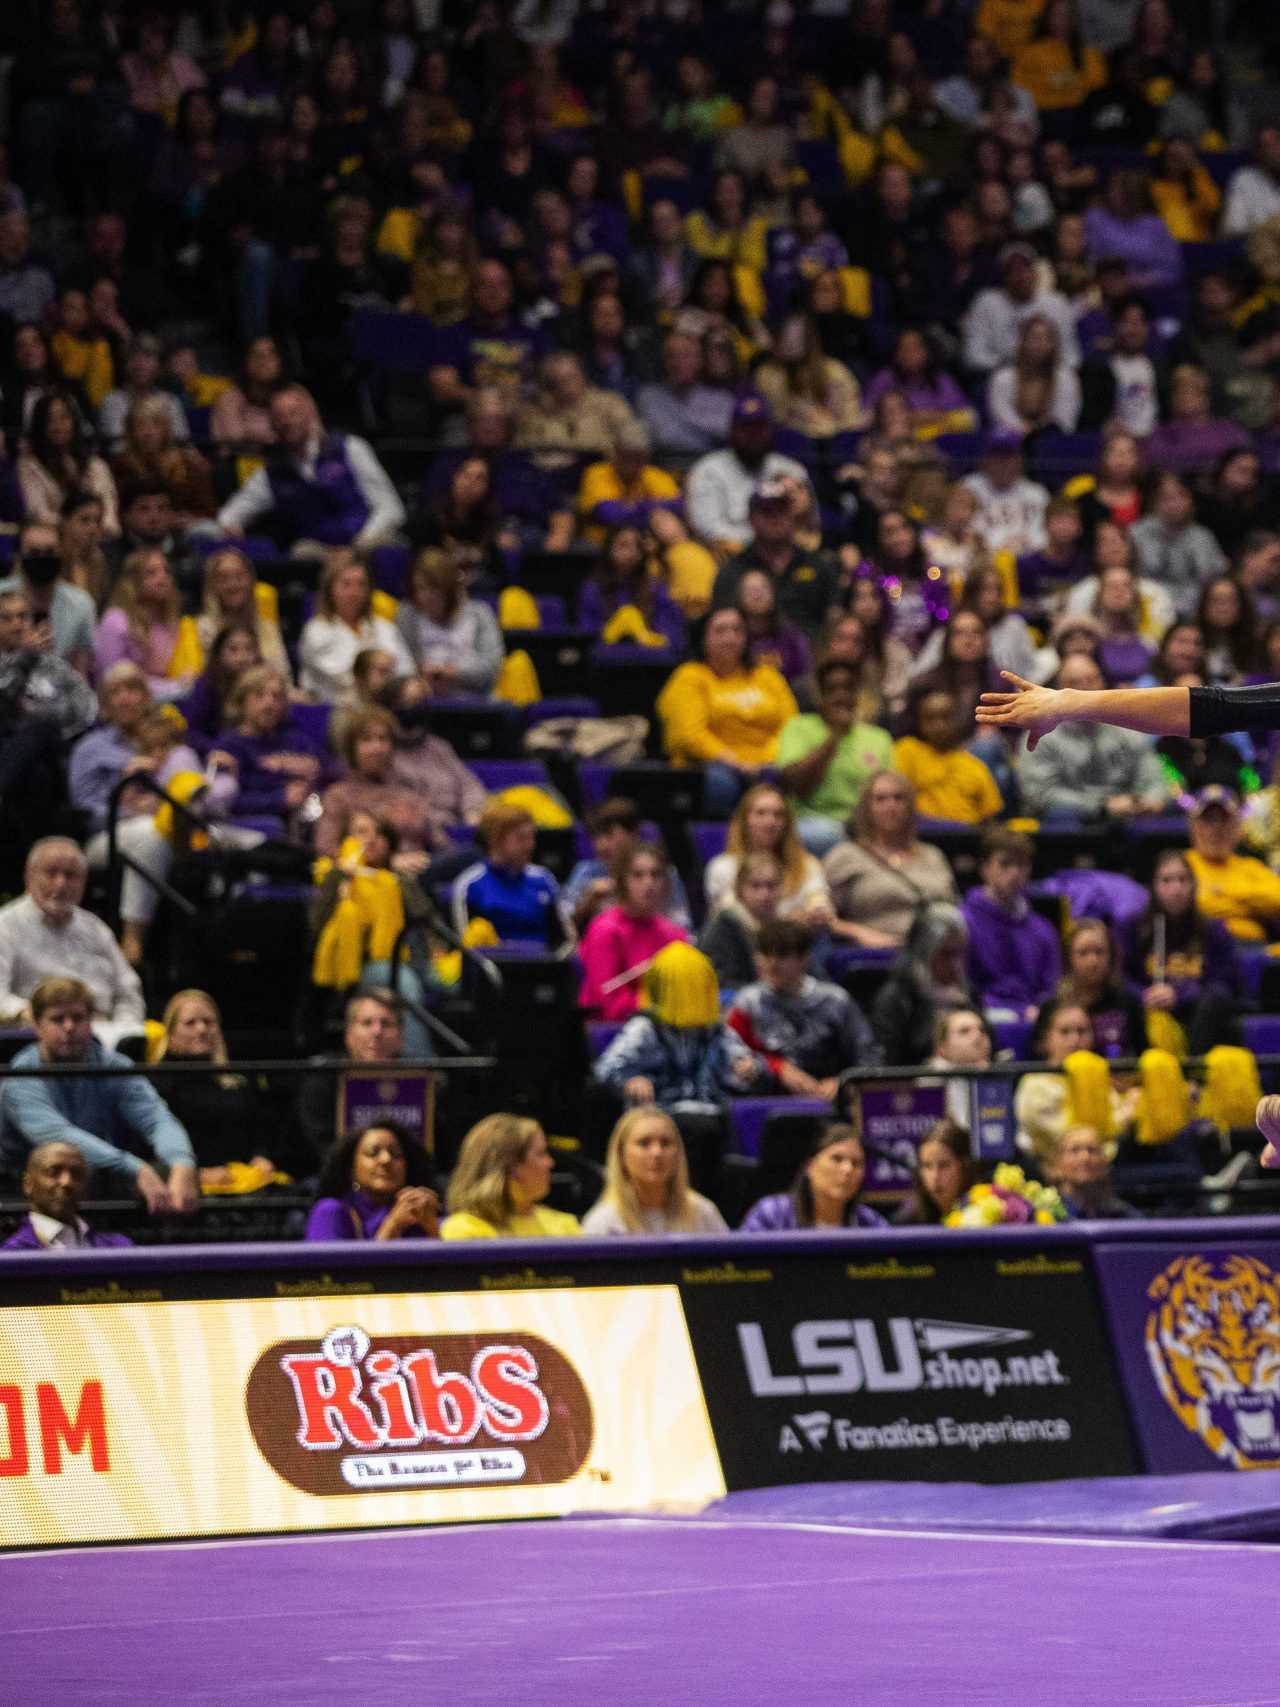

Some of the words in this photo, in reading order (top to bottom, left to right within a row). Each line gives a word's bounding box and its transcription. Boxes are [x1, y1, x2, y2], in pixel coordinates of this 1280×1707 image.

[736, 1317, 924, 1397] LSU
[924, 1349, 1067, 1397] shop.net
[779, 1424, 803, 1454] A
[832, 1417, 939, 1450] Fanatics
[936, 1414, 1072, 1451] Experience
